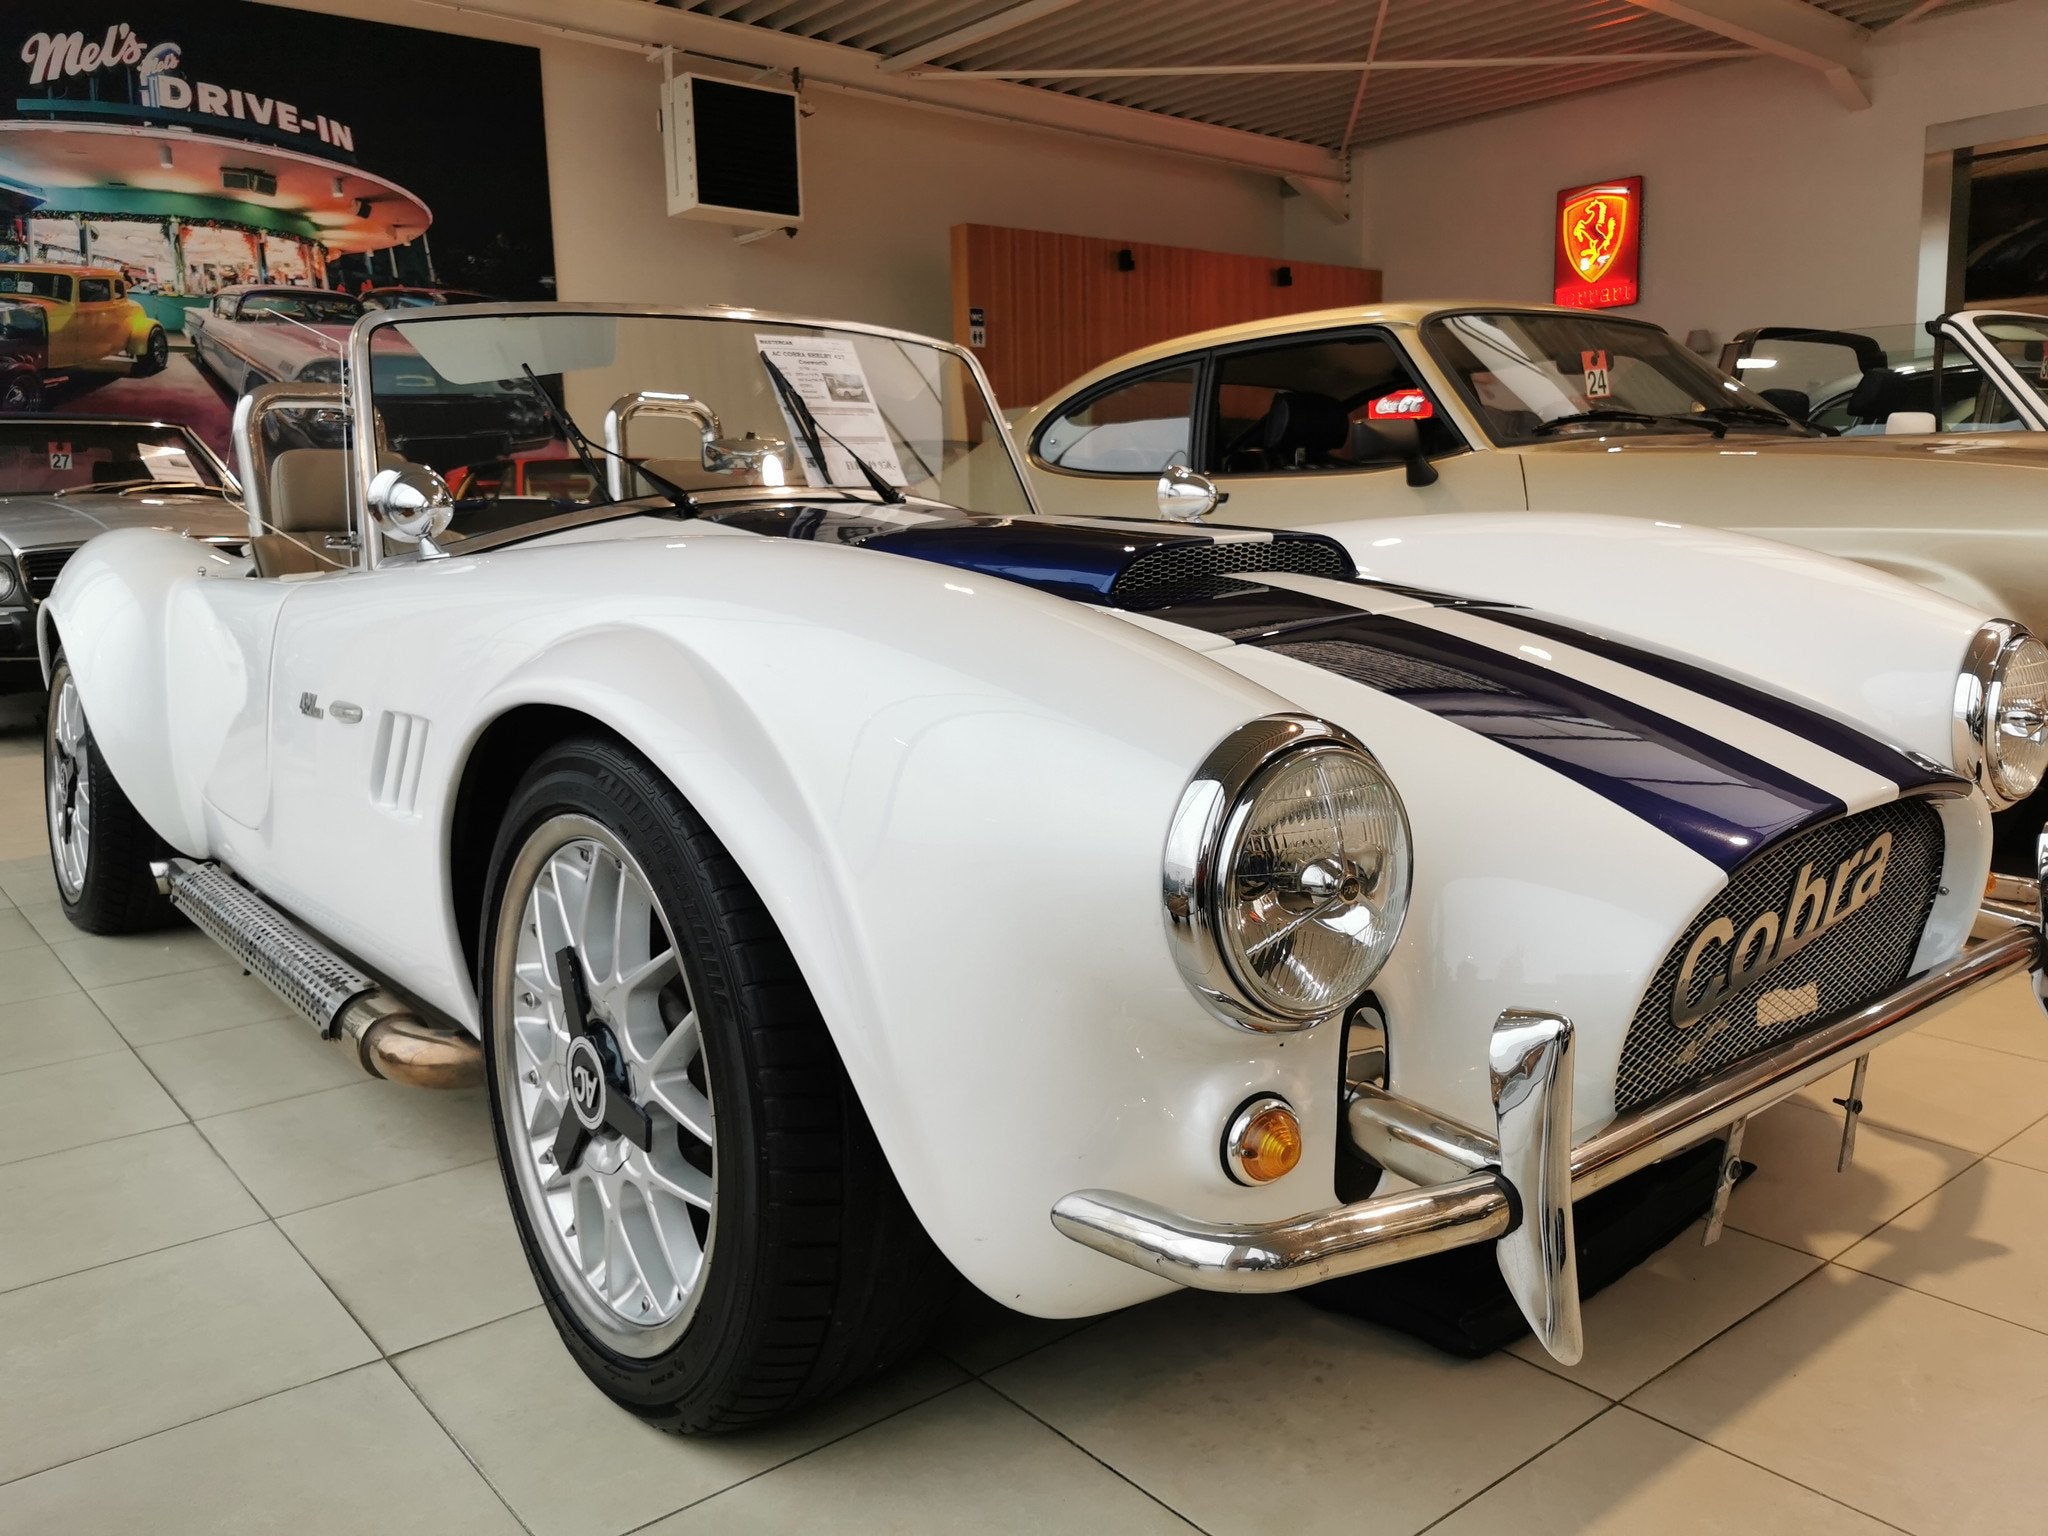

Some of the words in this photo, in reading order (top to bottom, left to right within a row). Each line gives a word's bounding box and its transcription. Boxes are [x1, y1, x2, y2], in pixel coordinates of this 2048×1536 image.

[21, 22, 148, 85] Mel's
[158, 74, 355, 152] DRIVE-IN
[1556, 284, 1631, 306] errari
[1587, 369, 1607, 395] 24
[52, 453, 70, 469] 27
[1670, 831, 1894, 1030] Cobra
